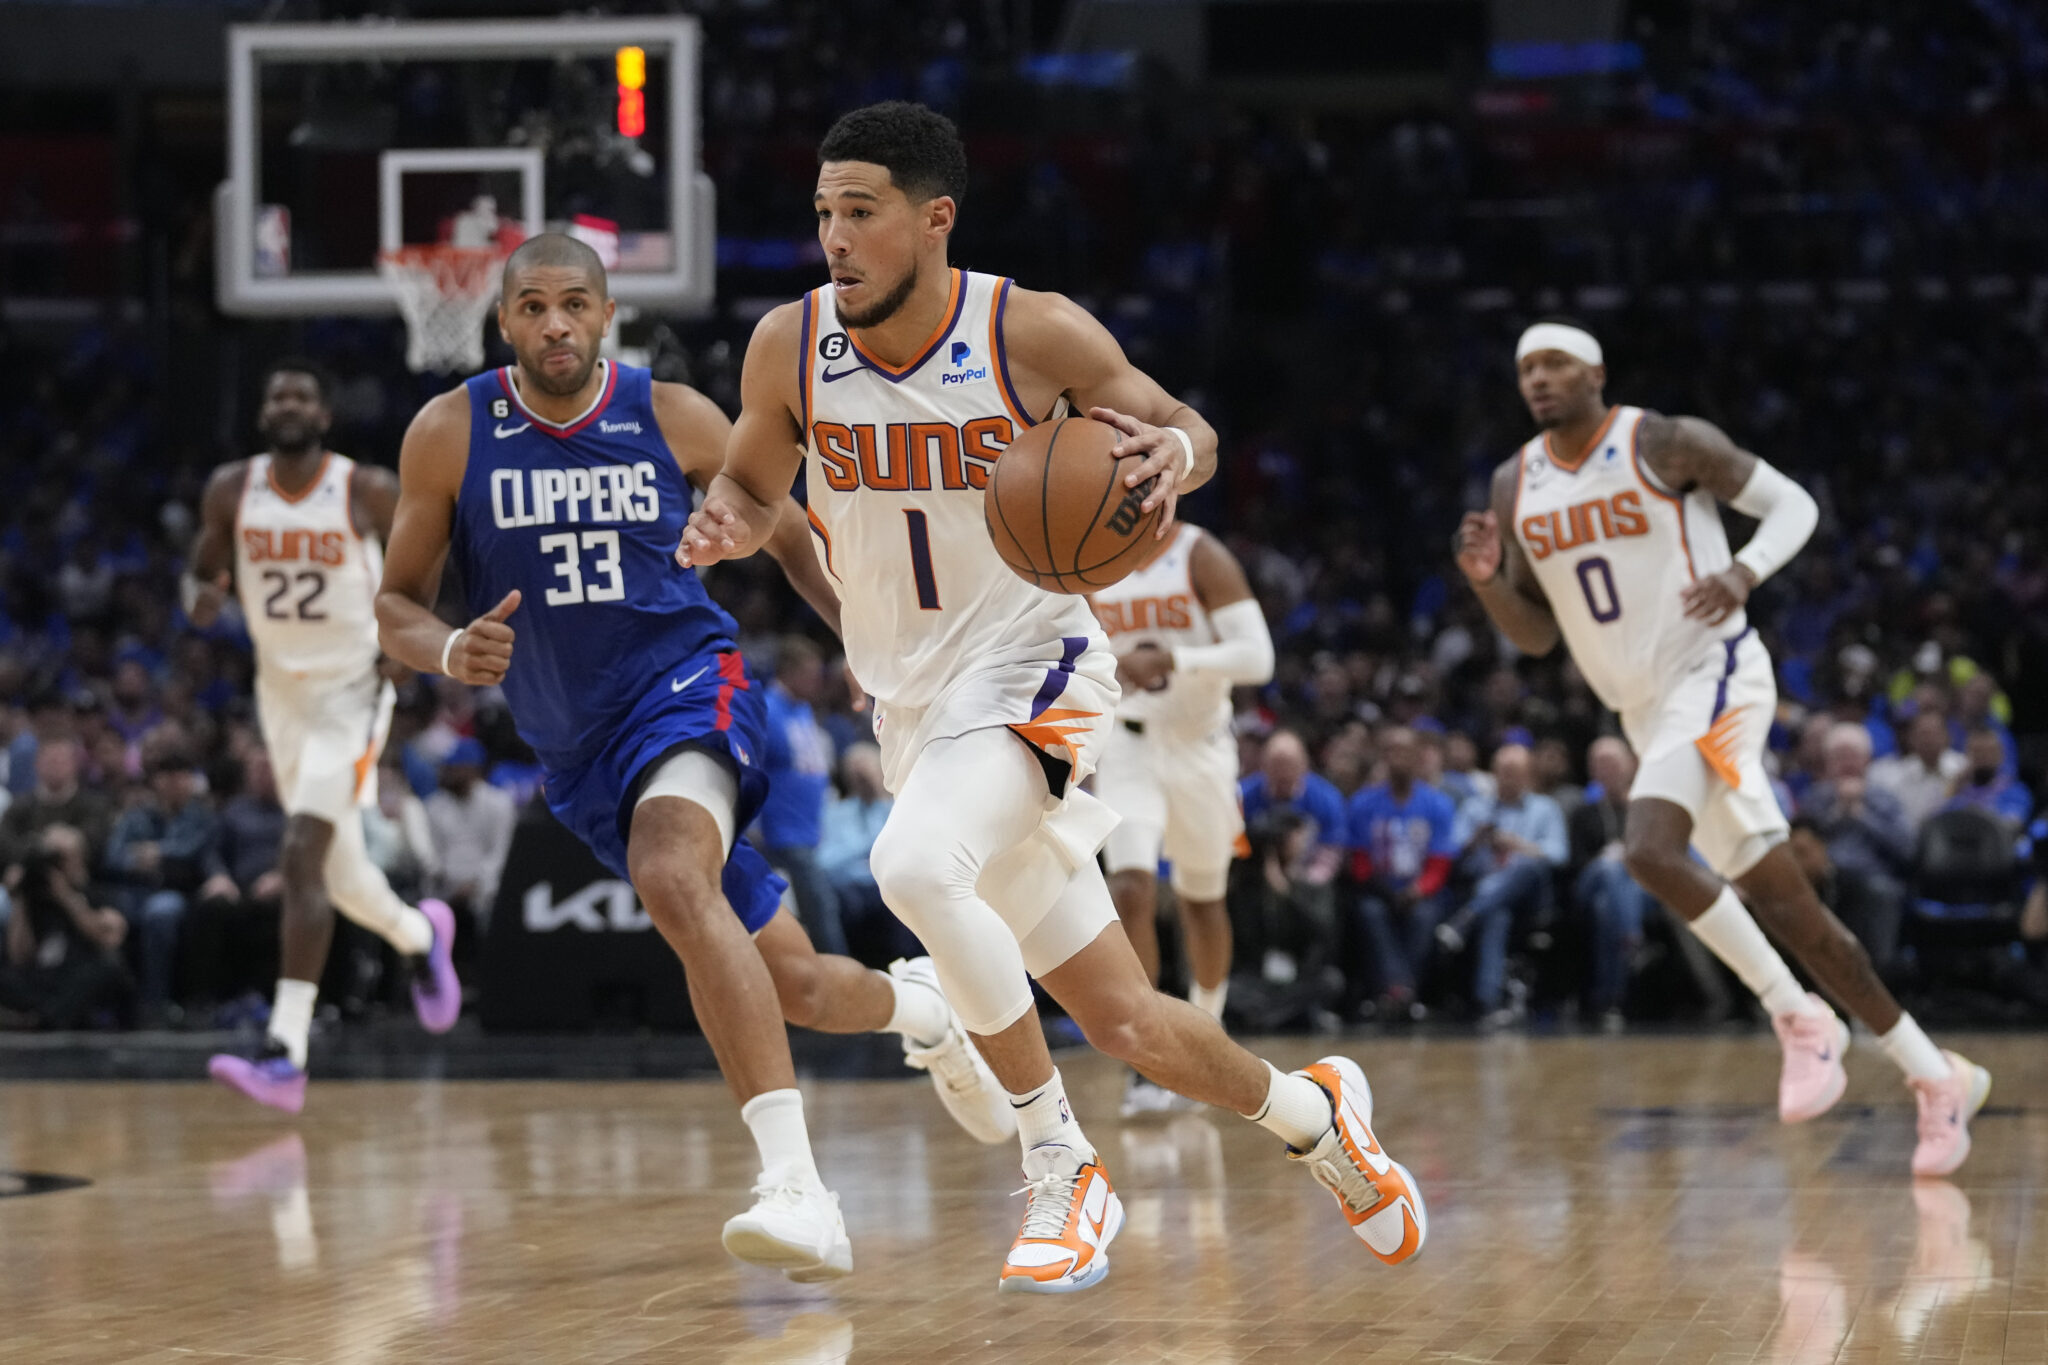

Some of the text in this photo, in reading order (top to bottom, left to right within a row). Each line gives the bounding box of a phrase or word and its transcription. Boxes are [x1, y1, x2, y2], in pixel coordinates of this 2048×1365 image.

[825, 336, 844, 357] 6
[942, 366, 986, 385] PayPal
[492, 398, 509, 418] 6
[599, 419, 643, 434] honey
[490, 461, 660, 529] CLIPPERS
[540, 529, 625, 607] 33
[901, 508, 943, 611] 1
[261, 569, 329, 622] 22
[1575, 556, 1622, 623] 0
